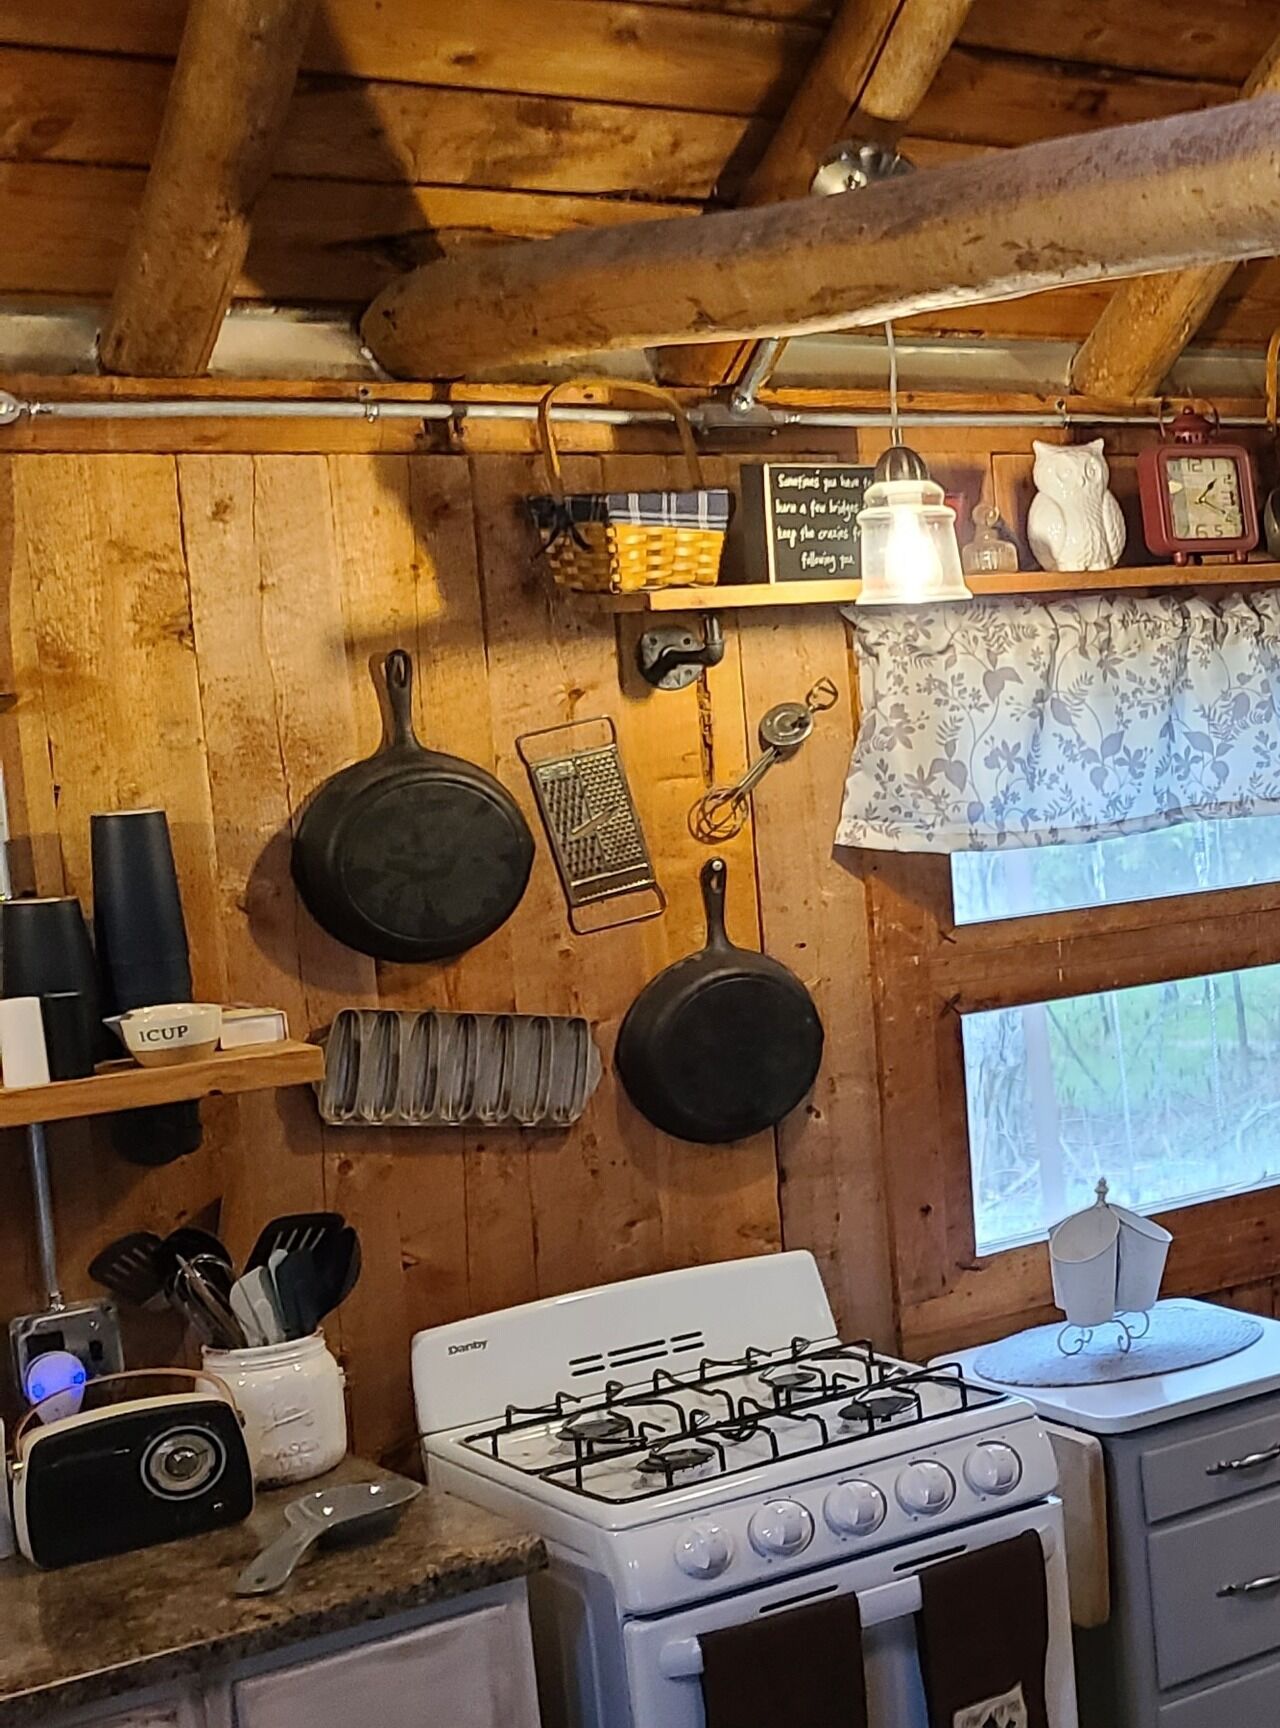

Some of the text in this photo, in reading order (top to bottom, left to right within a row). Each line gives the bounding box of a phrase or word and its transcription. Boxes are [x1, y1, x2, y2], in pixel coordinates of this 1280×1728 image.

[823, 478, 837, 493] you
[840, 474, 859, 489] have
[799, 503, 807, 515] a
[810, 498, 826, 518] few
[829, 498, 859, 522] bridges
[777, 525, 797, 548] keep
[800, 524, 815, 542] the
[818, 525, 848, 541] crazies
[801, 550, 836, 573] following
